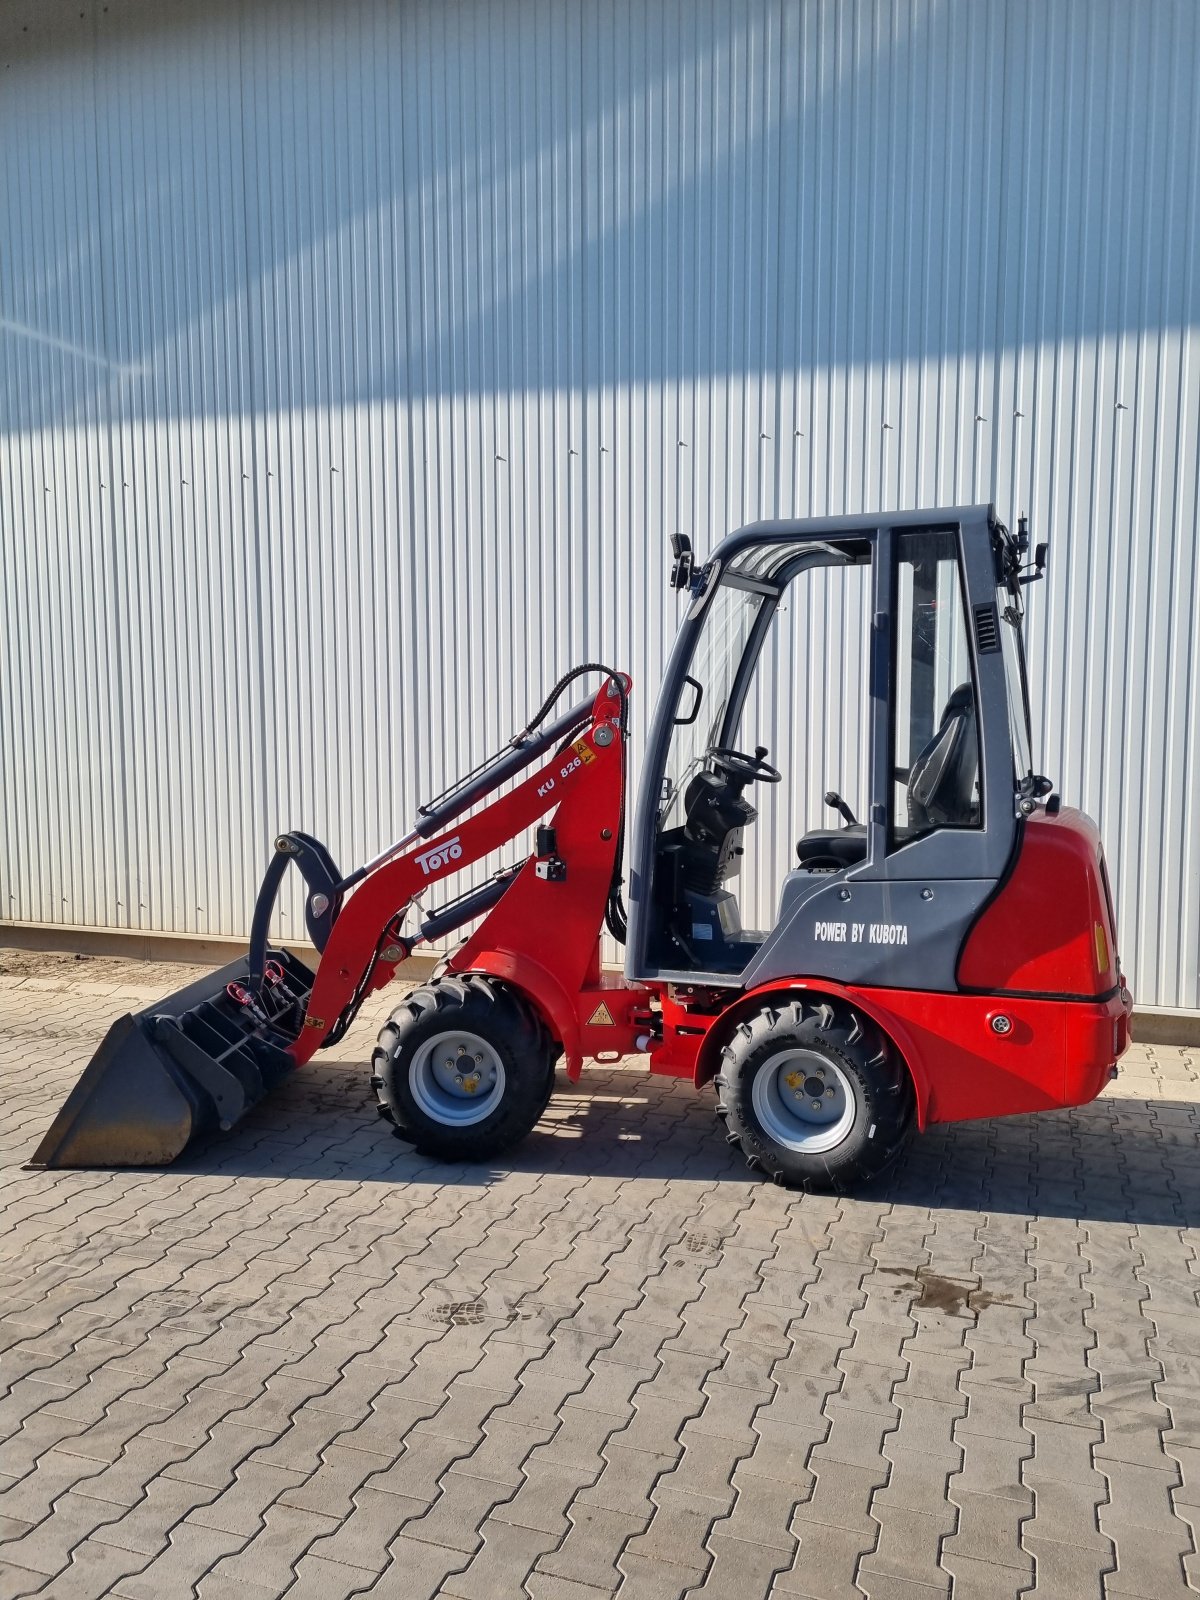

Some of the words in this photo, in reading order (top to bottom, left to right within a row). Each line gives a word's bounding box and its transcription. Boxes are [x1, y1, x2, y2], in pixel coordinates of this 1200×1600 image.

[537, 778, 555, 797] KU
[560, 756, 582, 778] 826
[414, 836, 463, 875] TOYO
[814, 921, 847, 942] POWER
[851, 923, 866, 943] BY
[869, 924, 908, 945] KUBOTA
